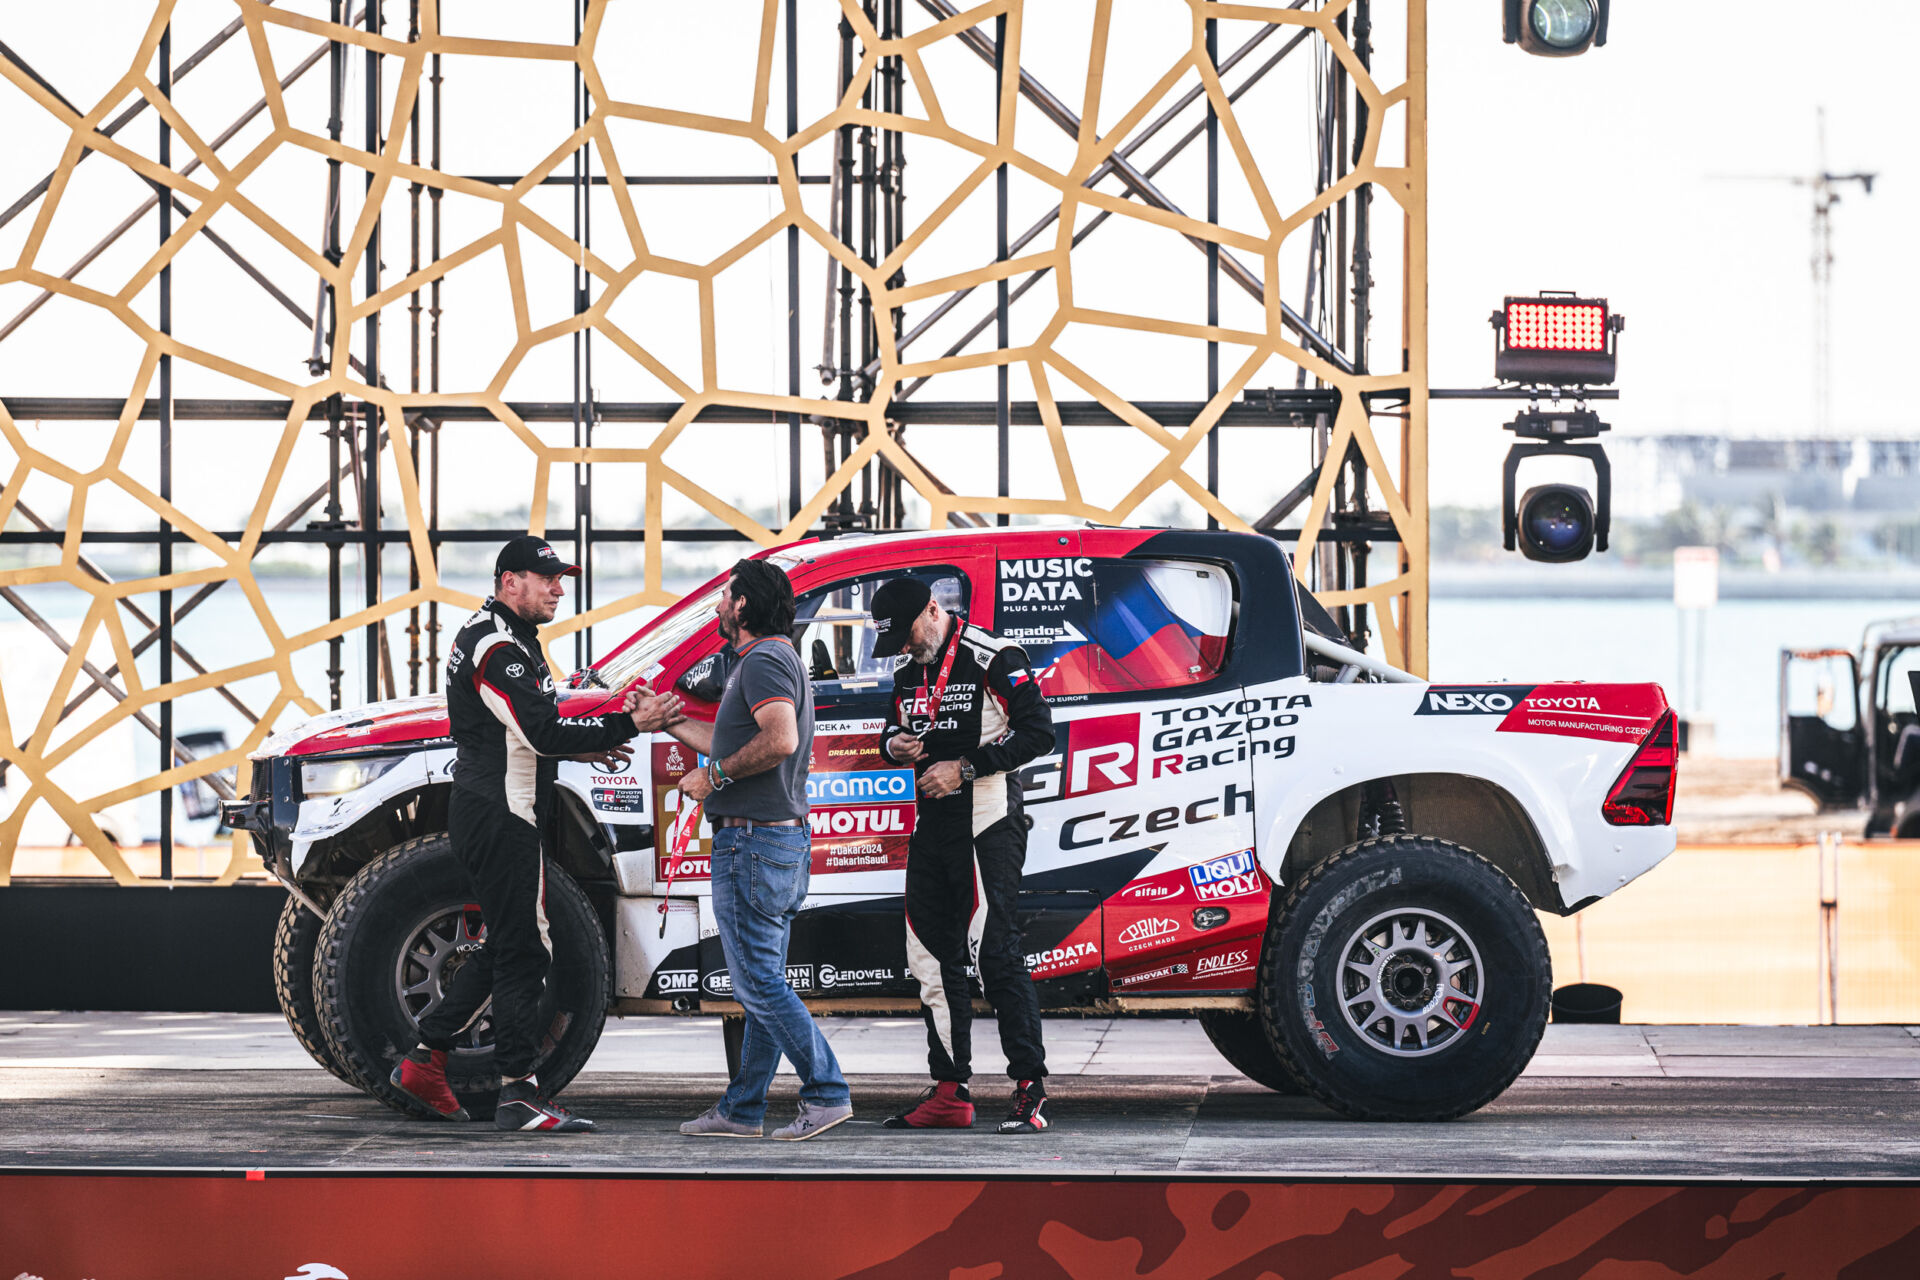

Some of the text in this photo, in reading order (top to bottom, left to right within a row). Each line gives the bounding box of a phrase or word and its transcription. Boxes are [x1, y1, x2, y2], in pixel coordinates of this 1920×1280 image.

[1000, 558, 1093, 579] MUSIC
[1001, 581, 1082, 601] DATA
[1004, 626, 1064, 638] agados
[929, 694, 972, 703] AZOO
[939, 702, 972, 712] acing
[1429, 693, 1513, 712] NEXO
[1525, 697, 1600, 710] TOYOTA
[1152, 695, 1312, 725] TOYOTA
[1152, 714, 1299, 752] GAZOO
[1528, 718, 1556, 727] MOTOR
[1558, 720, 1623, 733] MANUFACTURING
[1152, 735, 1296, 779] Racing
[1019, 742, 1134, 800] GR
[590, 776, 638, 785] TOYOTA
[594, 794, 615, 802] GR
[807, 809, 905, 834] MOTUL
[1059, 784, 1254, 850] Czech
[830, 844, 882, 855] #Dakar2024
[1193, 851, 1251, 884] LIQUI
[1198, 872, 1255, 898] MOLY
[1126, 918, 1169, 939] PRIM
[1129, 936, 1176, 951] CZECH MADE
[1059, 959, 1079, 967] PLAY
[1197, 950, 1248, 971] ENDLESS
[658, 973, 698, 989] OMP
[710, 976, 733, 988] BE
[1125, 969, 1170, 984] RENOVAK
